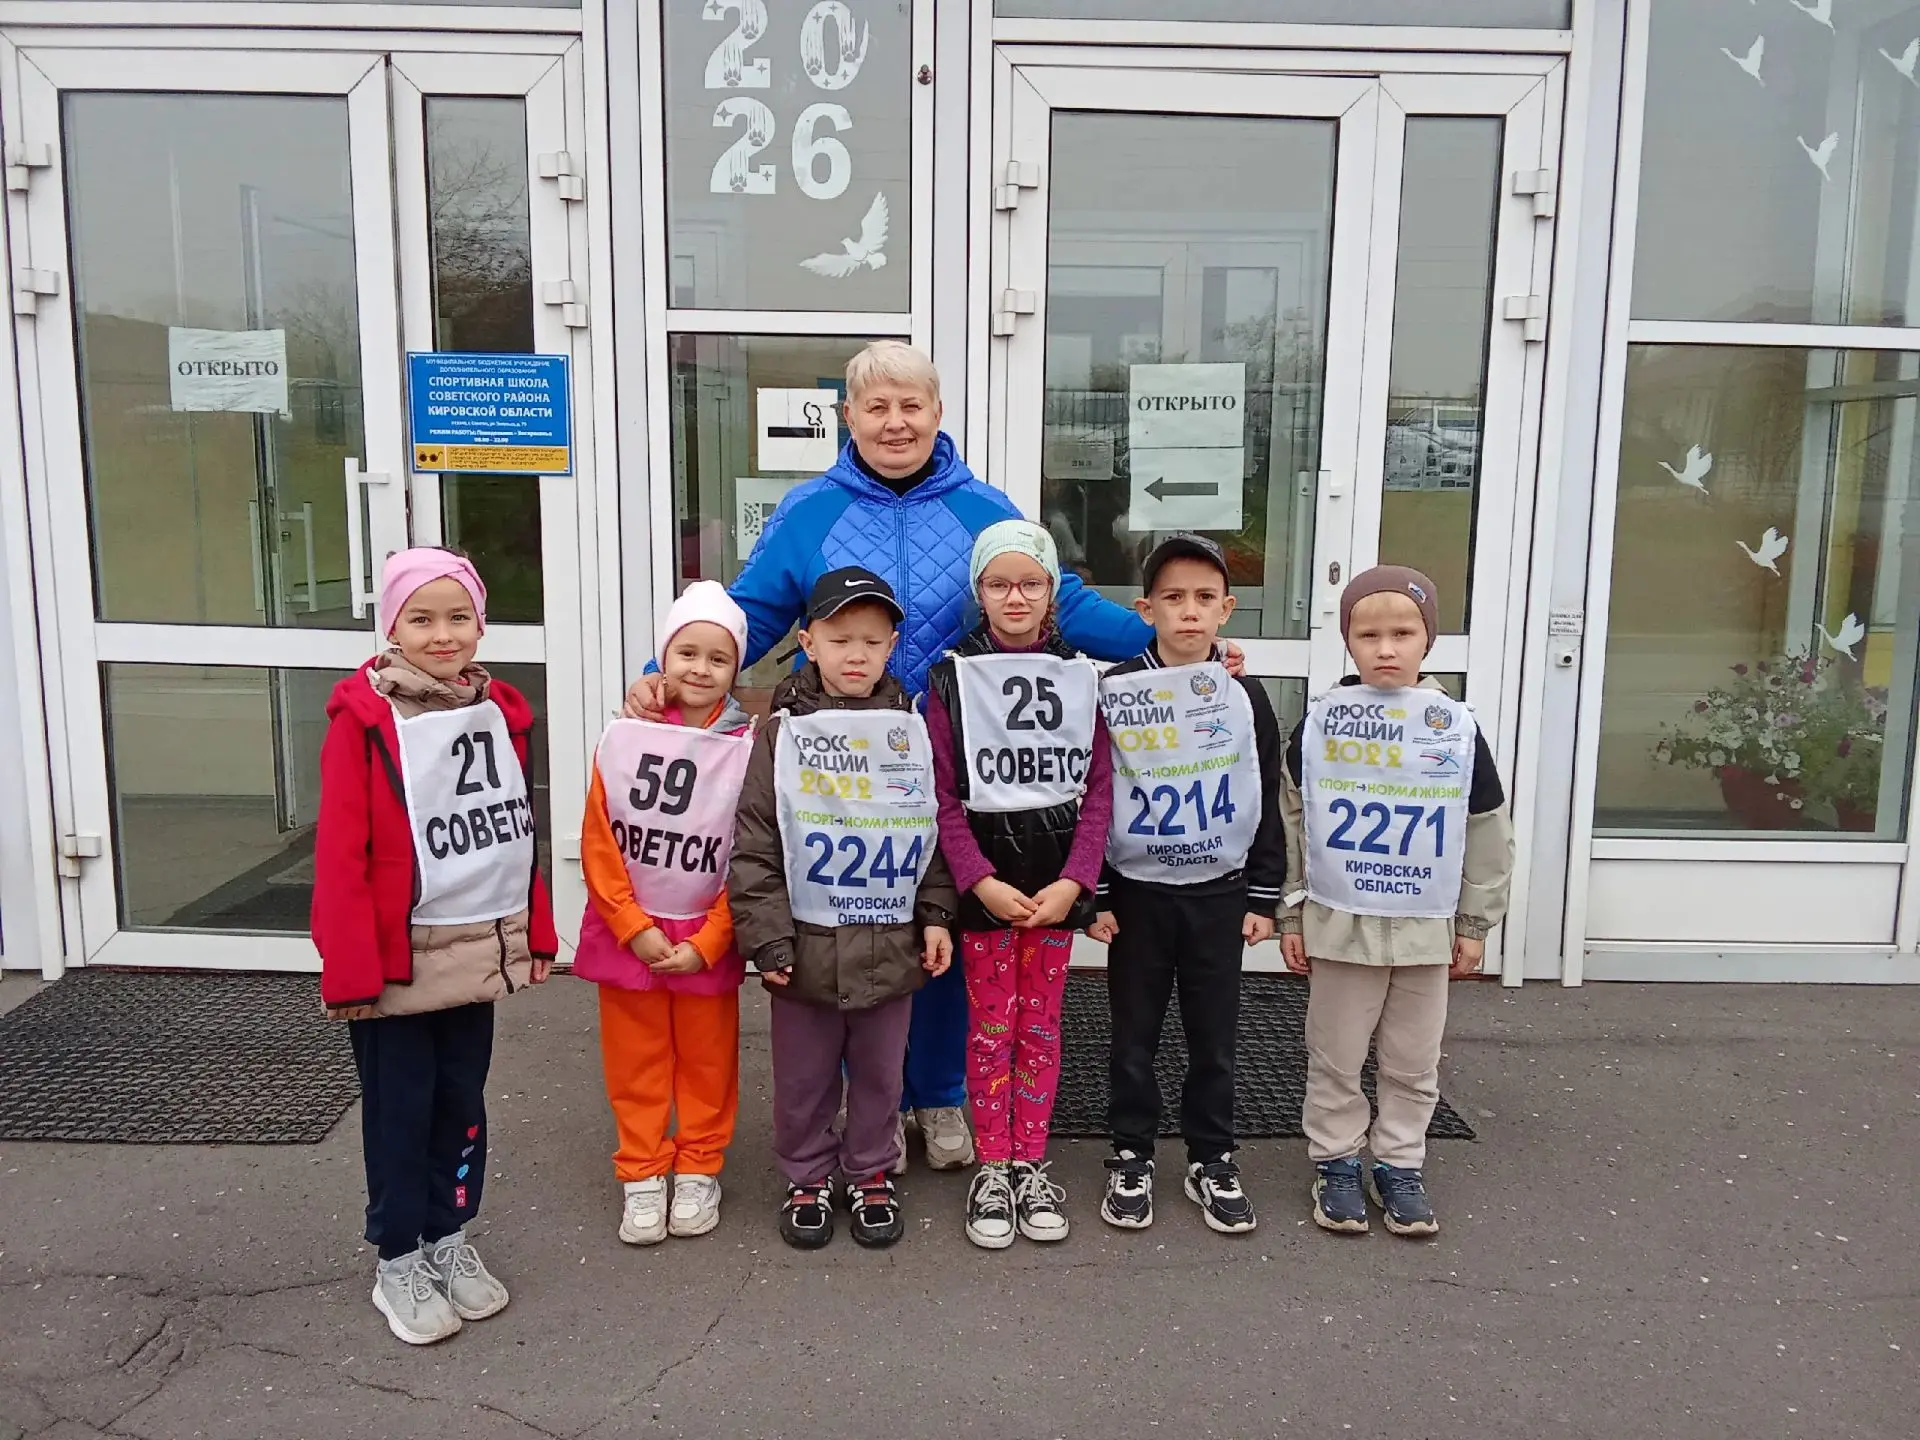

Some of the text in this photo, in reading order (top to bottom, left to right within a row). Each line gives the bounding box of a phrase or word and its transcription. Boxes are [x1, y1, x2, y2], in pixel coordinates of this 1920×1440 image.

[177, 360, 279, 376] ОТКРЫТО
[428, 376, 549, 389] СПОРТИВНАЯ ШКОЛА
[429, 391, 550, 403] СОВЕТСКОГО РАЙОНА
[1137, 395, 1236, 411] ОТКРЫТО
[428, 405, 552, 418] КИРОВСКОЙ ОБЛАСТИ
[1002, 676, 1063, 731] 25
[1326, 704, 1385, 720] КРОСС
[1114, 726, 1180, 752] 022
[1324, 719, 1404, 742] НАЦИИ
[1324, 738, 1402, 768] 2022
[451, 731, 502, 796] 27
[1152, 762, 1199, 778] НОРМА
[1200, 752, 1240, 772] ЖИЗНИ
[629, 753, 698, 816] 59
[798, 769, 873, 800] 2022
[1319, 778, 1463, 798] СПОРТ НОРМА ЖИЗНИ
[1128, 773, 1236, 836] 2214
[795, 809, 934, 828] СПОРТ НОРМА ЖИЗНИ
[1326, 798, 1446, 858] 2271
[1146, 836, 1223, 856] КИРОВСКАЯ
[804, 831, 923, 889] 2244
[1158, 855, 1218, 867] ОБЛАСТЬ
[1345, 860, 1432, 879] КИРОВСКАЯ
[1354, 878, 1422, 895] ОБЛАСТЬ
[828, 896, 907, 910] КИРОВСКАЯ
[837, 913, 899, 925] ОБЛАСТЬ
